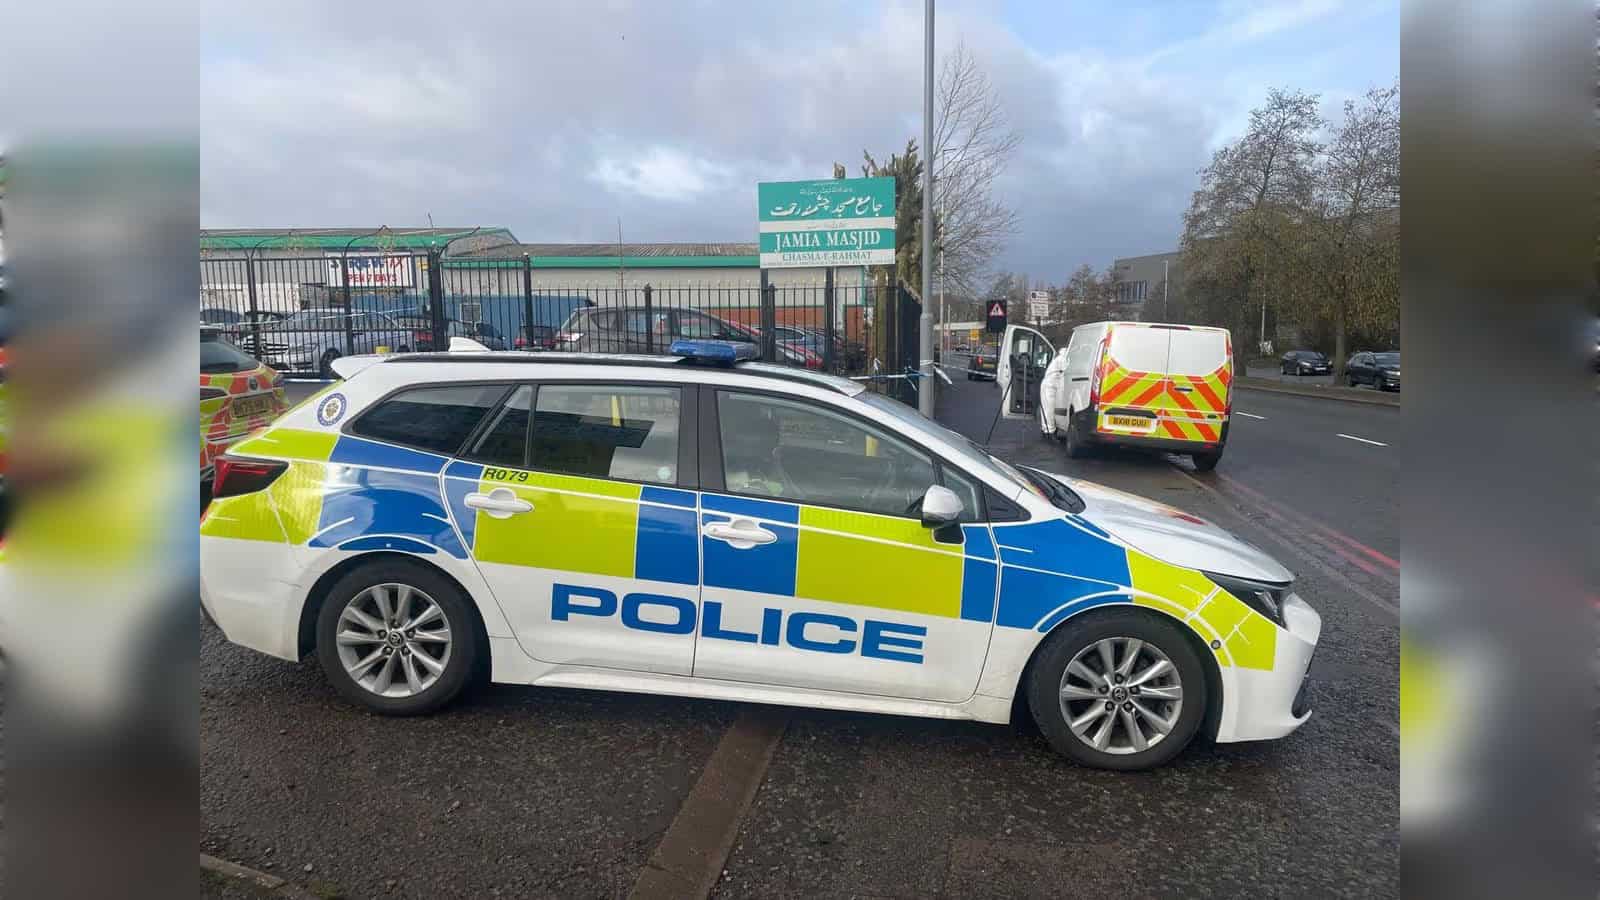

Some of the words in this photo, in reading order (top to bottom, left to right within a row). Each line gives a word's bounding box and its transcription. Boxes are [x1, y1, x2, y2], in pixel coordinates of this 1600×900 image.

[831, 197, 856, 217] مسجد
[775, 232, 820, 253] JAMIA
[826, 230, 881, 249] MASJID
[551, 583, 927, 664] POLICE
